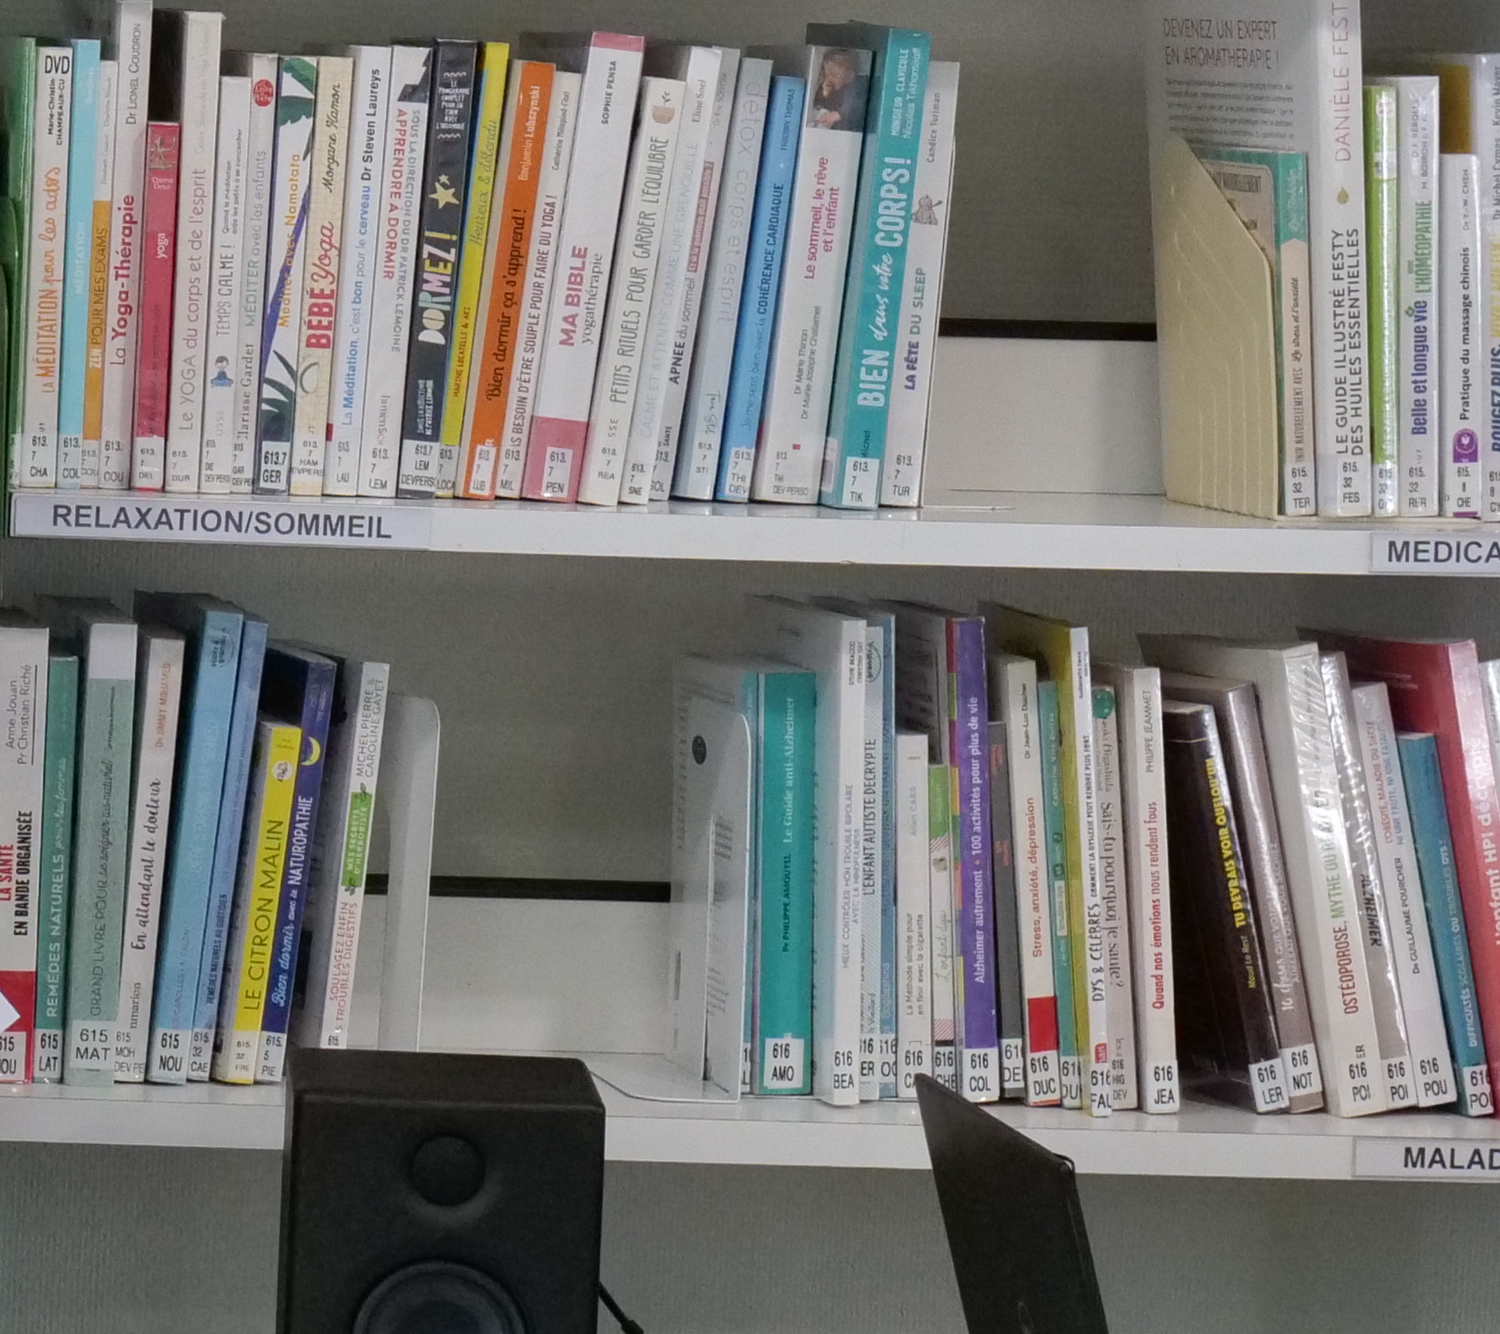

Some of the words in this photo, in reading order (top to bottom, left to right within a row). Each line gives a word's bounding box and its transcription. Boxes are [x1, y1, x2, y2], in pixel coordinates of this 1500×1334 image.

[43, 54, 71, 75] DVD
[111, 194, 135, 340] Yoga-Thérapie
[1331, 229, 1345, 285] FESTY
[417, 245, 456, 345] DORMEZ
[857, 348, 890, 408] BIEN
[874, 170, 909, 249] CORPS
[1346, 227, 1360, 354] ESSENTIELLES
[1332, 288, 1347, 373] ILLUSTRÉ
[111, 346, 126, 366] La
[1335, 376, 1348, 430] GUIDE
[1349, 360, 1363, 421] HUILES
[1336, 435, 1348, 455] LE
[1350, 426, 1364, 456] DES
[51, 504, 393, 540] RELAXATION/SOMMEIL
[16, 810, 33, 875] ORGANISÉE
[259, 819, 284, 888] MALIN
[14, 878, 30, 917] BANDE
[14, 919, 28, 936] EN
[248, 897, 273, 980] CITRON
[245, 987, 261, 1011] LE
[160, 1032, 180, 1049] 615
[772, 1043, 791, 1059] 616
[159, 1057, 182, 1073] NOU
[771, 1066, 795, 1082] AMO
[1153, 1065, 1174, 1083] 616
[1153, 1088, 1176, 1105] JEA
